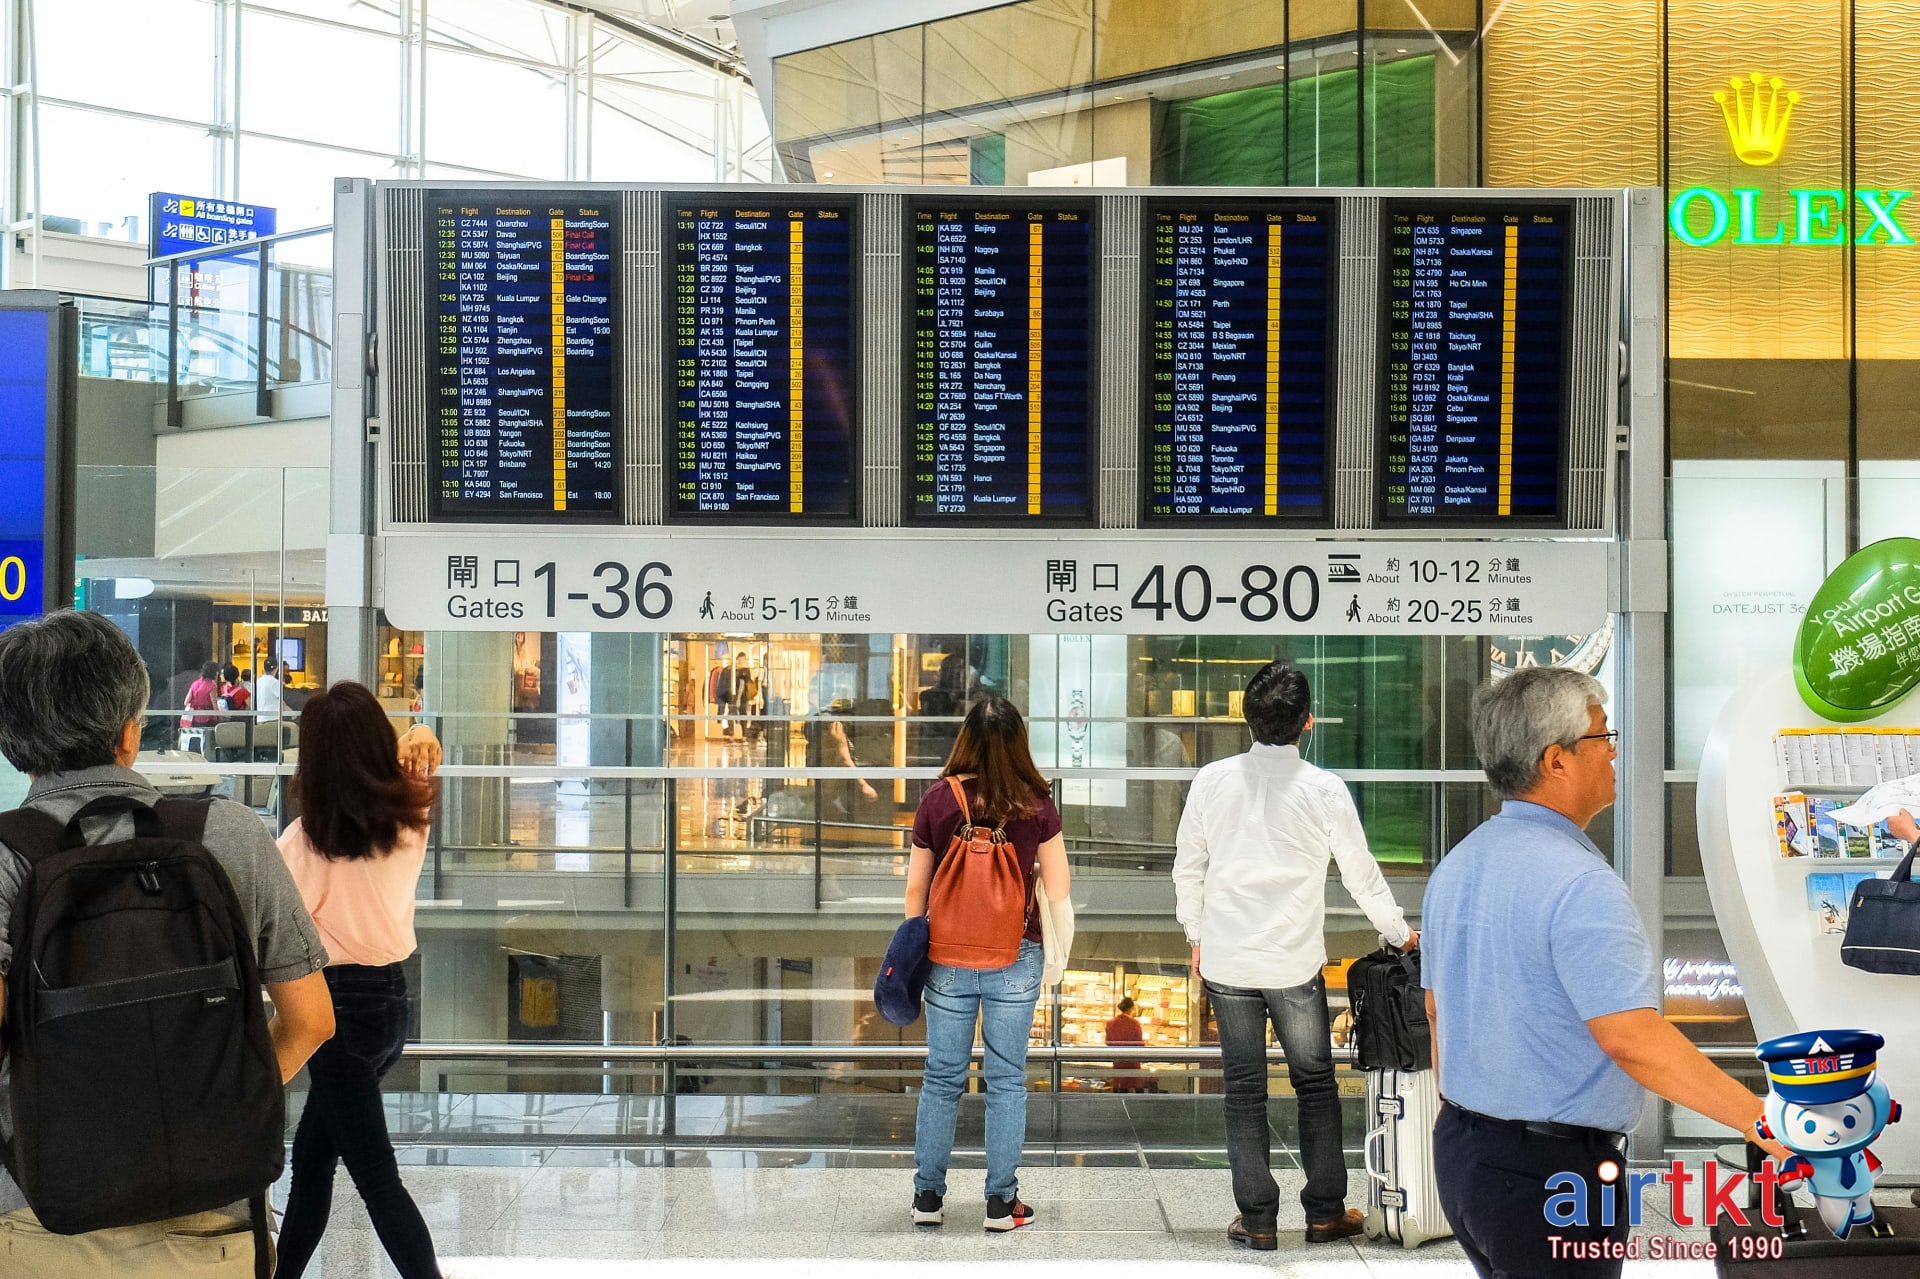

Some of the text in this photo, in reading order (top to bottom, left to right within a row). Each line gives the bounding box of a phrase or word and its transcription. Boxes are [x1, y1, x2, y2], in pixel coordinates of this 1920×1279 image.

[438, 207, 599, 217] Time Flight Destination Gate Status
[677, 209, 839, 219] Time Flight Destination Gate Status
[917, 212, 1078, 221] Time Flight Destination Gate Status
[207, 214, 234, 224] boarding
[236, 217, 253, 225] gates
[1156, 213, 1317, 223] Time Flight Destination Gate Status
[1393, 214, 1553, 224] Time Flight Destination Gate Status
[496, 219, 529, 228] Quanzhou
[565, 220, 609, 230] BoardingSoon
[735, 222, 767, 230] Seoul/ICN
[496, 230, 516, 238] Davao
[566, 230, 580, 239] Final
[582, 231, 595, 239] Call
[1451, 226, 1482, 236] Singapore
[1214, 247, 1235, 255] Phuket
[974, 267, 995, 275] Manila
[497, 294, 515, 302] Kuala
[516, 294, 540, 303] Lumpur
[566, 294, 581, 303] Gate
[582, 294, 607, 304] Change
[735, 307, 756, 315] Manila
[1213, 352, 1246, 362] Tokyo/NRT
[1212, 373, 1236, 382] Penang
[974, 382, 1006, 392] Nanchang
[513, 490, 543, 499] Francisco
[749, 492, 780, 501] Francisco
[992, 495, 1016, 503] Lumpur
[1444, 495, 1471, 505] Bangkok
[1387, 557, 1399, 571] 約
[1489, 558, 1520, 571] 分鐘
[448, 556, 519, 589] 閘口
[1410, 560, 1479, 582] 10-12
[0, 556, 26, 601] 0
[1047, 560, 1118, 593] 閘口
[1367, 574, 1531, 583] About Minutes
[535, 562, 672, 619] 1-36
[1131, 565, 1319, 622] 40-80
[448, 595, 523, 618] Gates
[741, 595, 754, 609] 約
[827, 596, 858, 609] 分鐘
[1387, 598, 1400, 611] 約
[1489, 598, 1520, 611] 分鐘
[763, 598, 819, 620] 5-15
[1047, 599, 1122, 622] Gates
[1408, 600, 1482, 622] 20-25
[1712, 604, 1807, 614] DATEJUST 36
[1832, 586, 1920, 638] Airport G
[721, 611, 870, 621] About Minutes
[1367, 614, 1532, 623] About Minutes
[1828, 614, 1920, 674] 機場指南
[1895, 645, 1920, 668] 伴您
